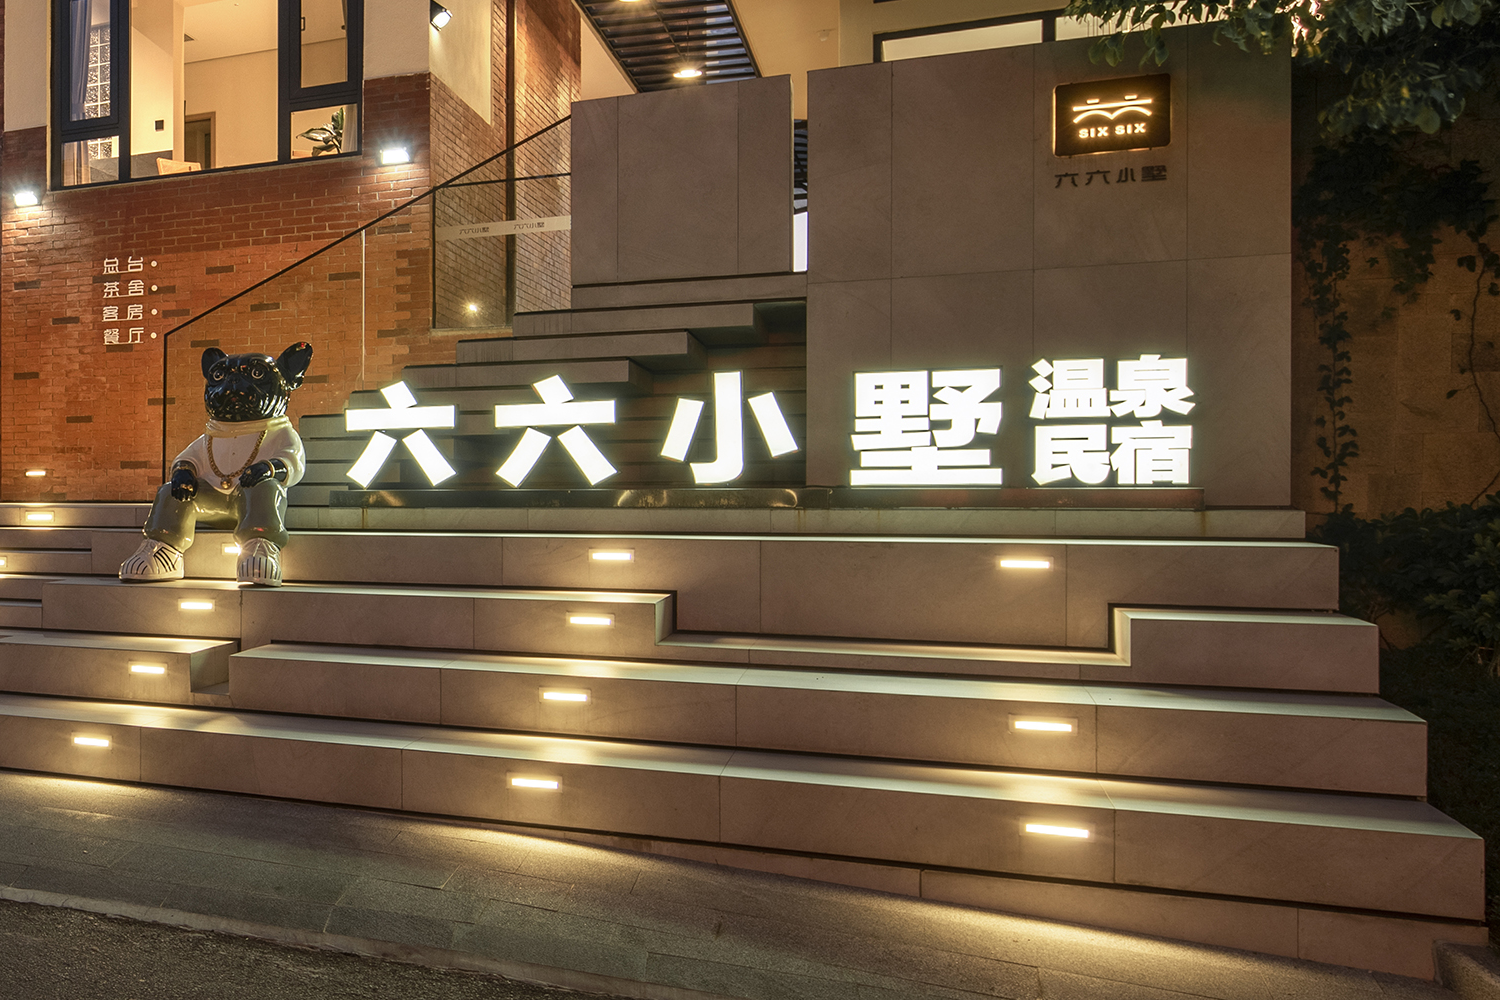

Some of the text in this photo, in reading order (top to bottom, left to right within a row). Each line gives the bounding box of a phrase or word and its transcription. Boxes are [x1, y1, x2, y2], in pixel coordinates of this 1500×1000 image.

[1078, 121, 1147, 139] SIX SIX
[1054, 164, 1168, 189] 六六小墅
[102, 255, 144, 274] 总台
[102, 279, 145, 298] 茶舍
[101, 303, 144, 322] 客房
[102, 326, 145, 345] 餐厅
[1028, 353, 1196, 420] 温泉
[344, 368, 1003, 490] 六六小墅
[1030, 419, 1193, 486] 民宿
